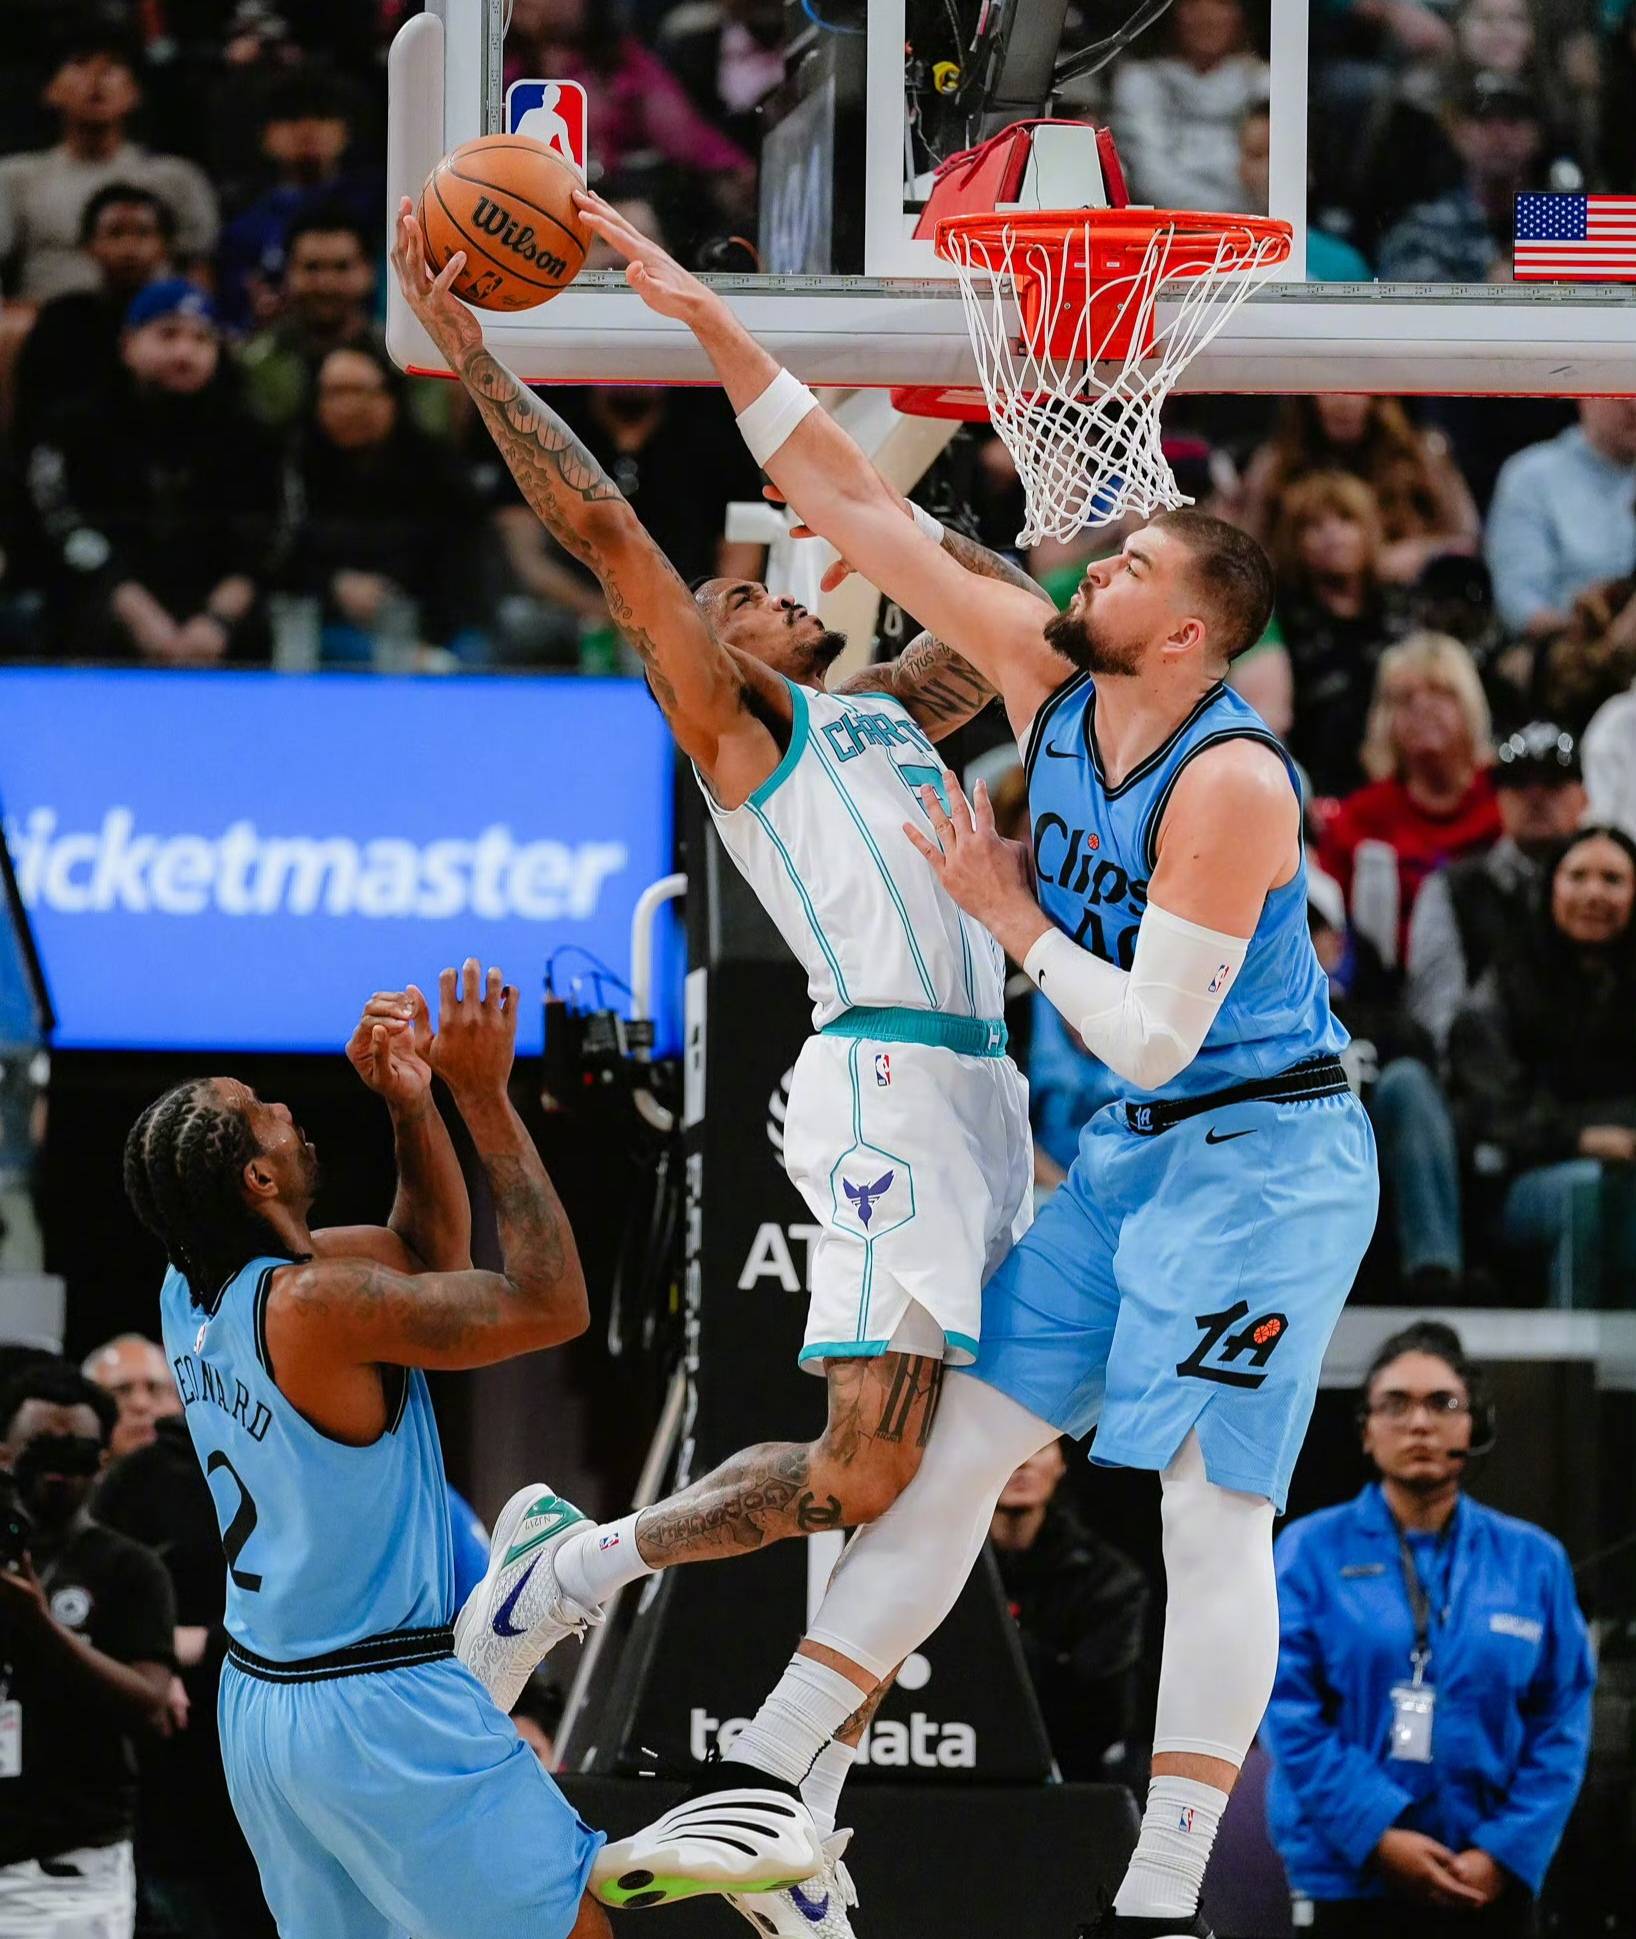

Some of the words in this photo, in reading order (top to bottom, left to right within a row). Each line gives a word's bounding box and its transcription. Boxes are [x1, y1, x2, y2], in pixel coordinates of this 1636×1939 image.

[471, 196, 567, 280] Wilson
[5, 807, 626, 920] icketmaster
[1033, 811, 1148, 917] Clips
[1176, 1299, 1289, 1389] LA
[207, 1450, 263, 1592] 2
[690, 1707, 977, 1767] teata
